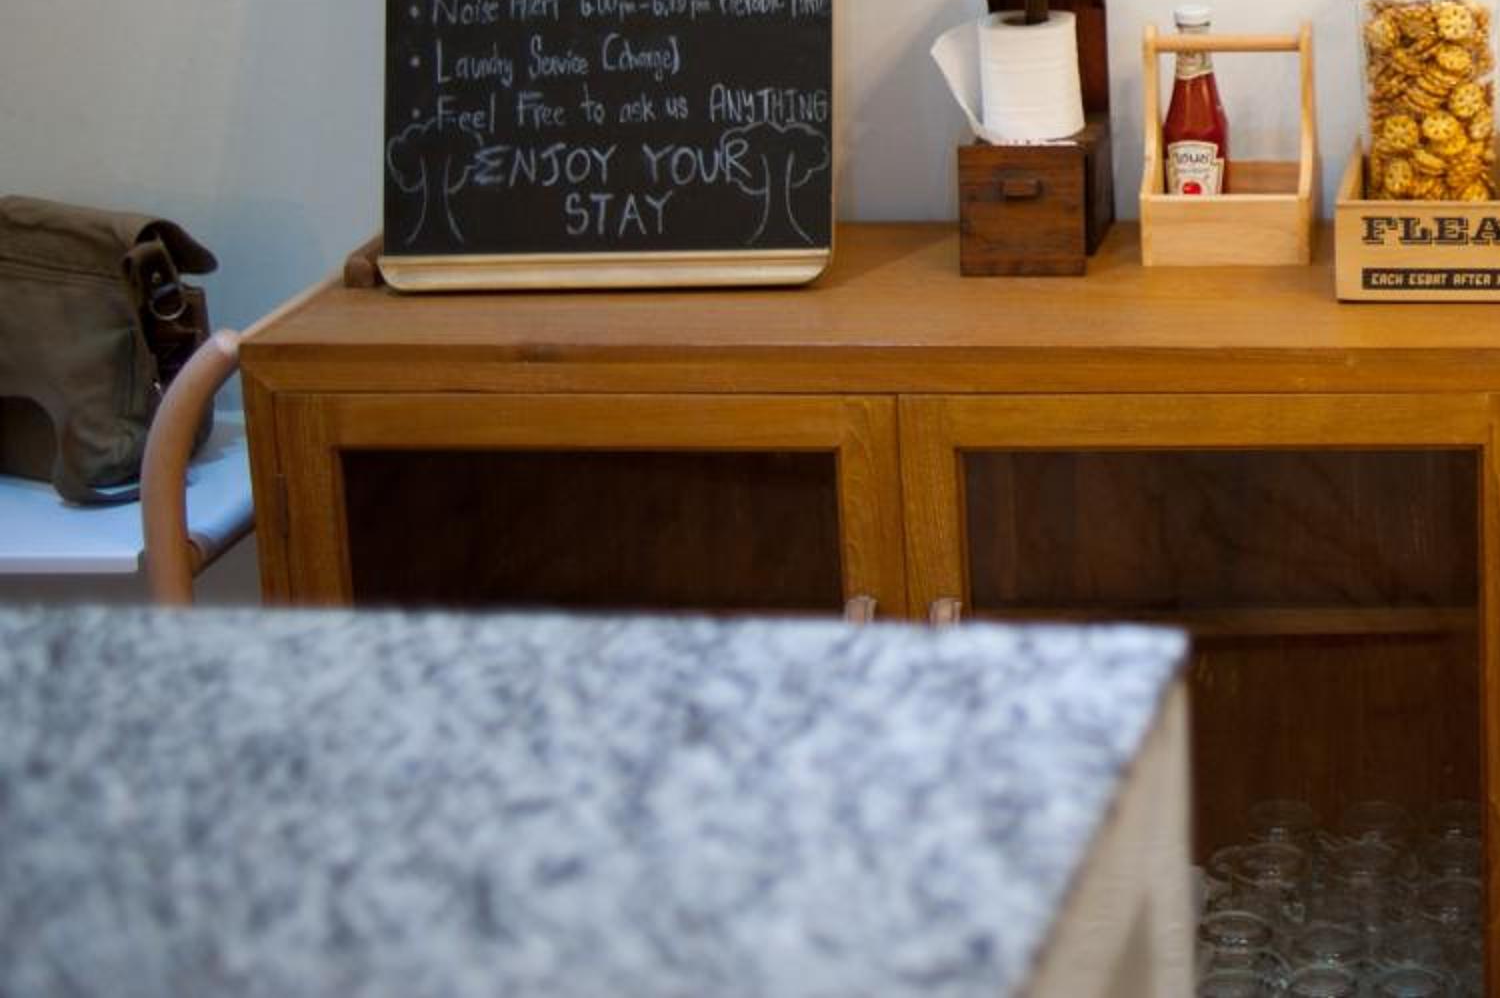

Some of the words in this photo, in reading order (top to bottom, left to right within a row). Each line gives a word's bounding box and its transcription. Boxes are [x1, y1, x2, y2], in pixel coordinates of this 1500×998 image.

[436, 37, 513, 87] Laundry
[436, 92, 496, 132] Feel
[579, 82, 606, 124] to
[619, 92, 656, 124] ask
[667, 95, 689, 120] us
[708, 82, 829, 126] ANYTHING
[472, 142, 617, 187] ENJOY
[643, 139, 752, 184] YOUR
[565, 191, 673, 236] STAY
[1371, 273, 1403, 286] EACH
[1453, 273, 1491, 286] AFTER
